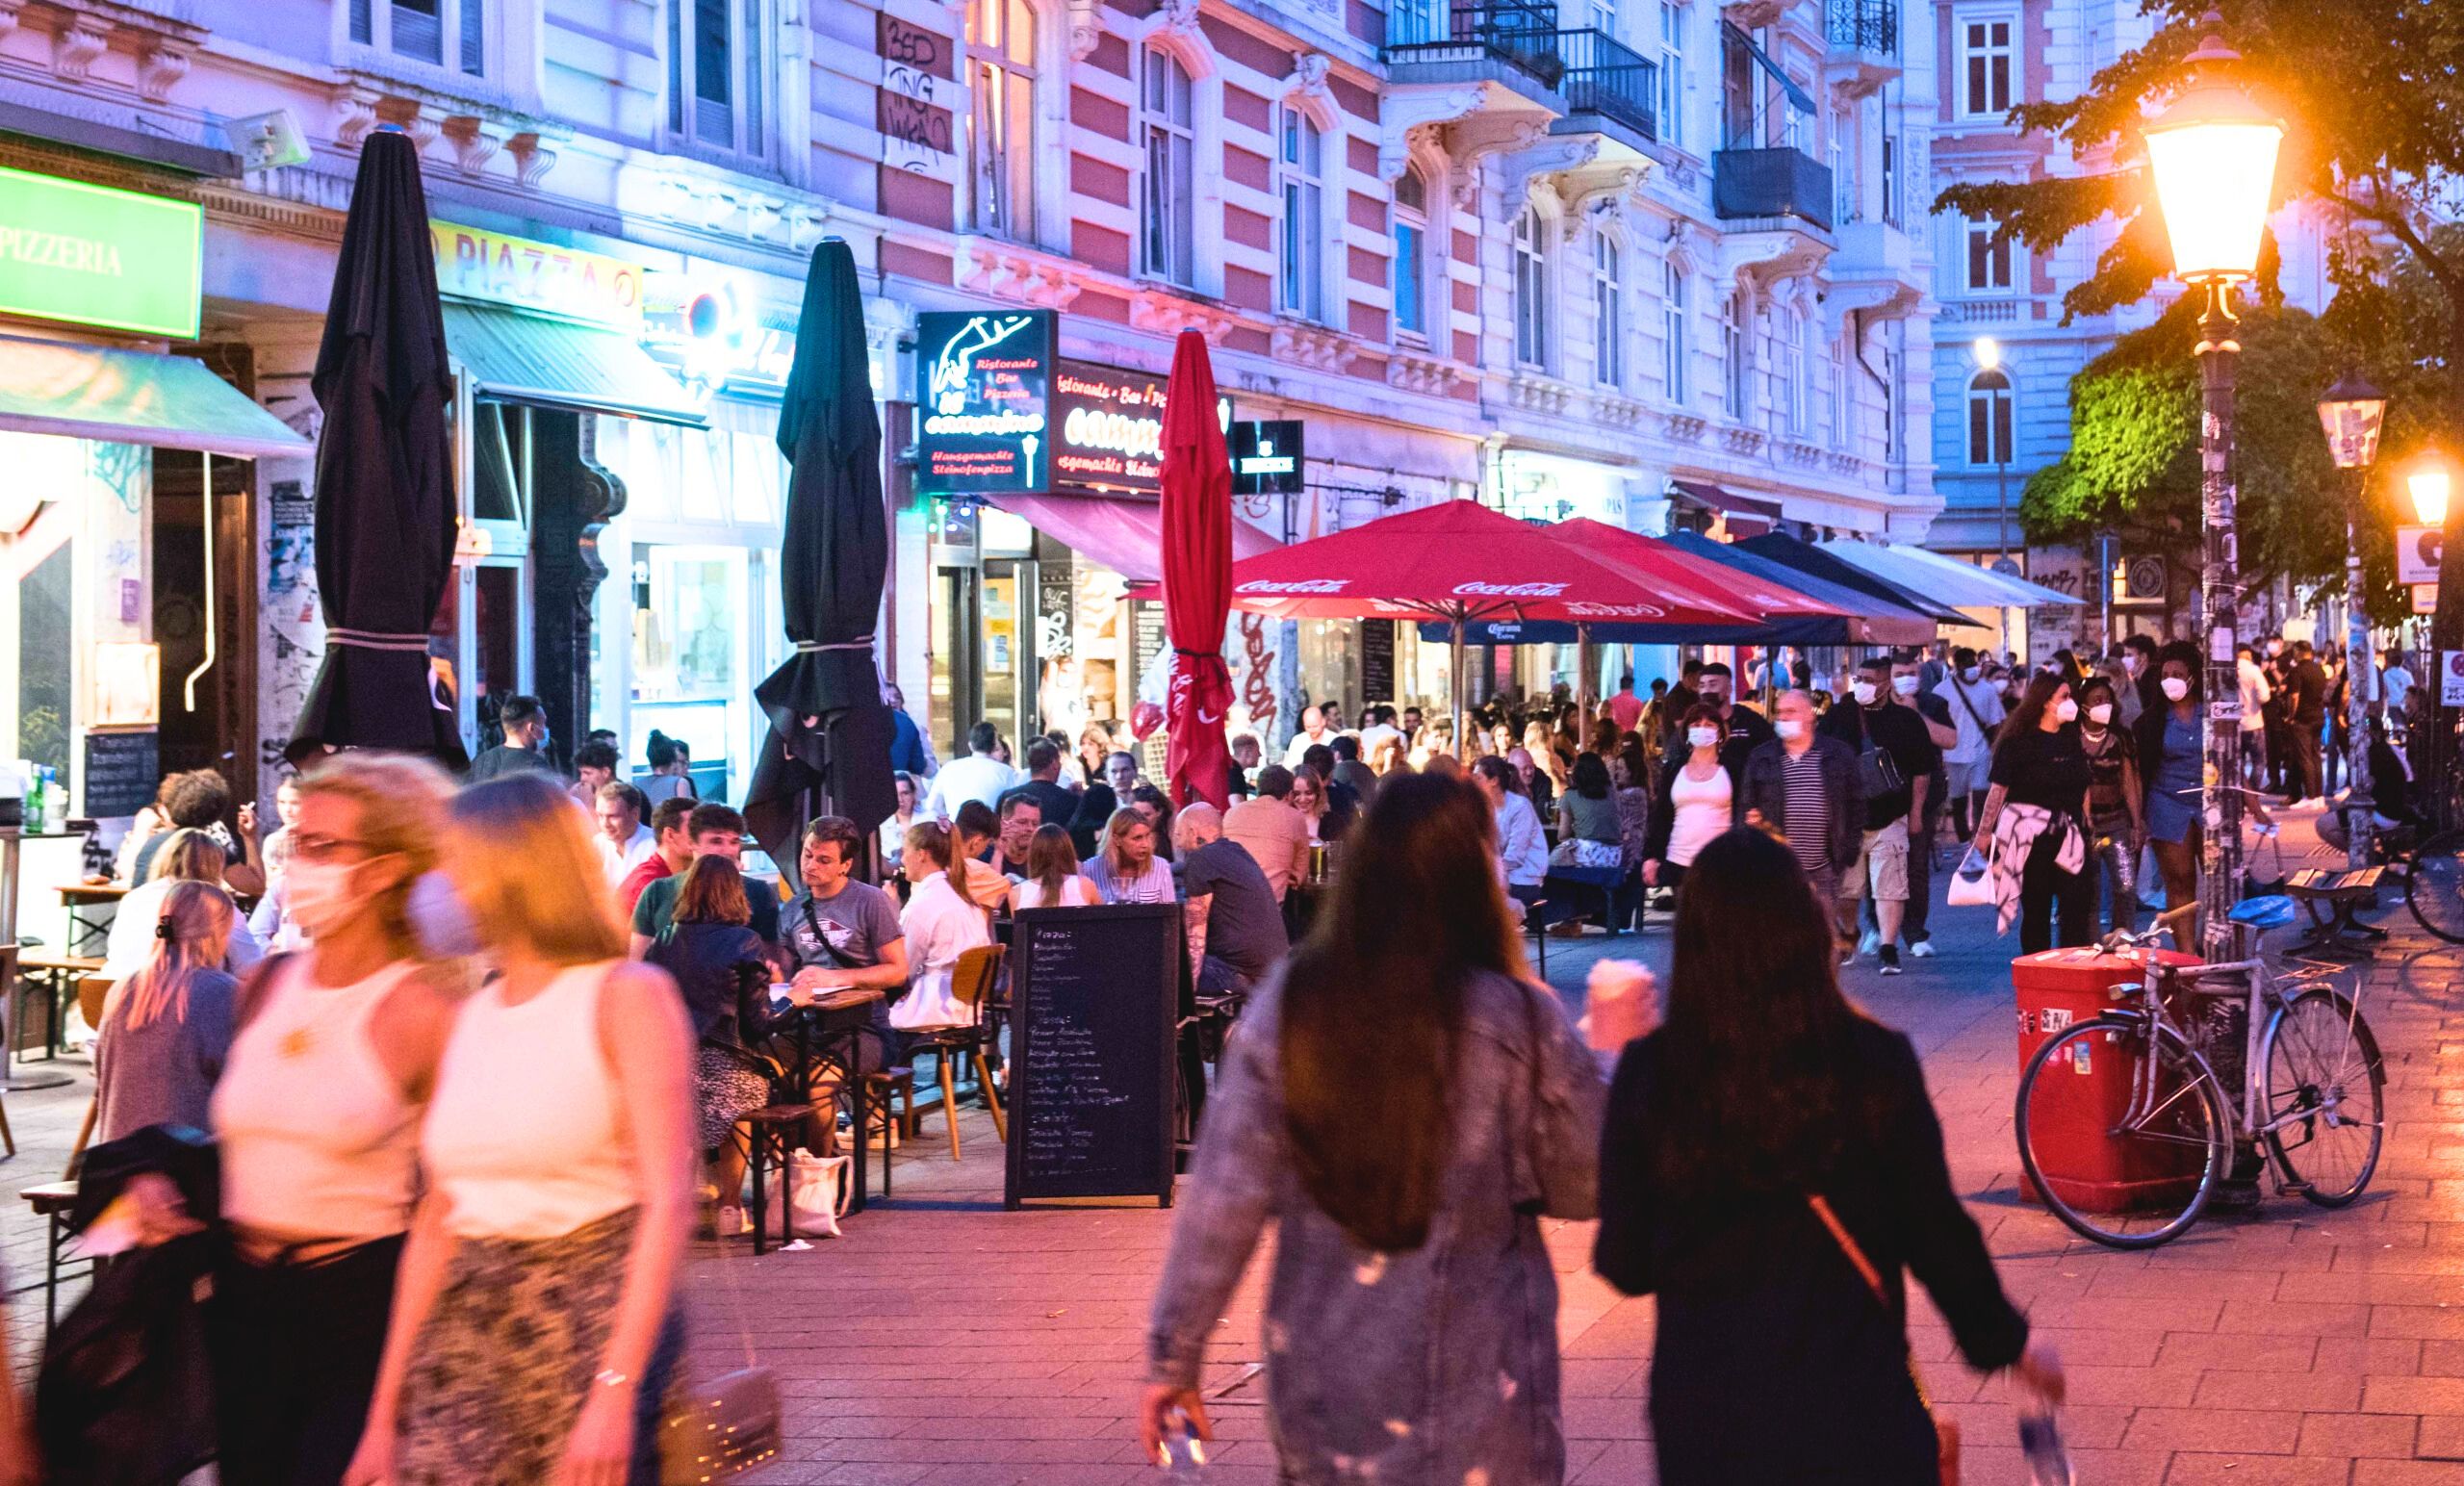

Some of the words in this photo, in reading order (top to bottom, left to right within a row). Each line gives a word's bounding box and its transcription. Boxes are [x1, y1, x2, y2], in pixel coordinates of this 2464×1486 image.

[0, 224, 123, 277] PIZZERIA
[976, 358, 1040, 370] Ristorante
[995, 372, 1019, 384] Bar
[1057, 374, 1110, 398] istorante
[984, 388, 1031, 399] Pizzeria
[1452, 581, 1572, 597] Coca-Cola
